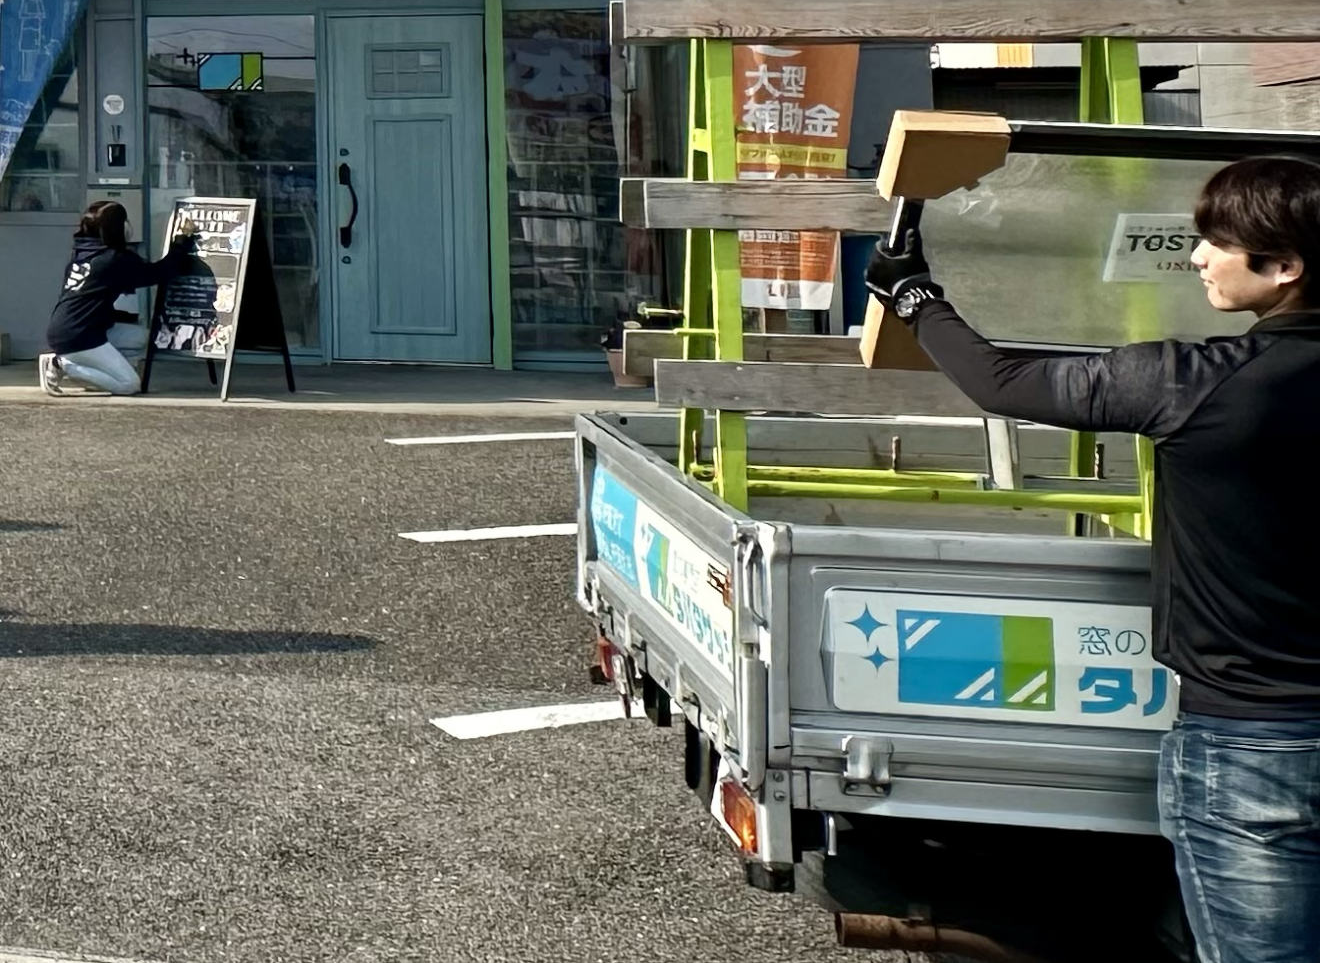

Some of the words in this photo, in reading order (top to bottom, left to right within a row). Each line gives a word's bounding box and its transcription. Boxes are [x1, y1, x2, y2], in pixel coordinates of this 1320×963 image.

[744, 64, 807, 98] 大型
[742, 97, 841, 138] 補助金
